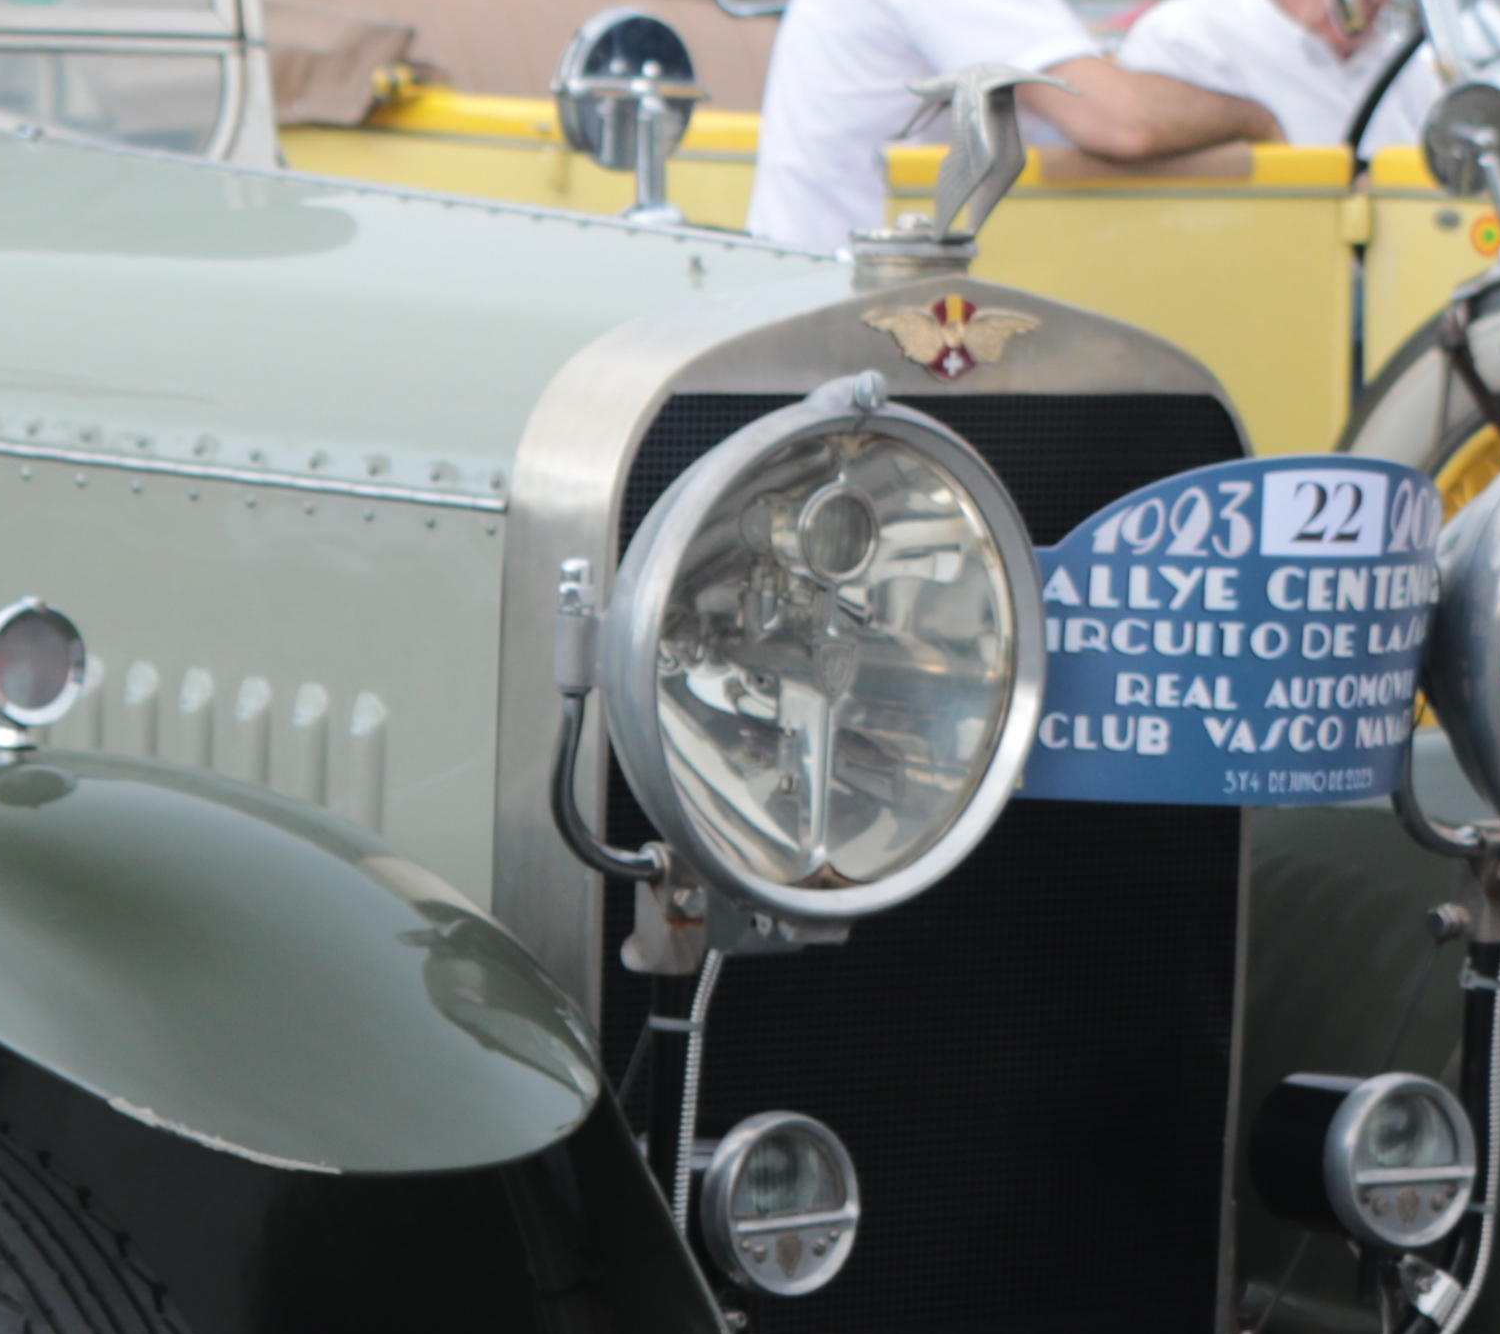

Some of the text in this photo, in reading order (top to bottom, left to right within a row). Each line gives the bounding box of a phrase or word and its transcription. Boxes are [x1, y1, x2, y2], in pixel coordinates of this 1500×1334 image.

[1092, 481, 1254, 559] 1923
[1290, 481, 1363, 543] 22
[1042, 565, 1238, 611] ALLYE
[1046, 617, 1290, 659] IRCUITO
[1301, 622, 1357, 660] DE
[1115, 672, 1238, 710] REAL
[1038, 712, 1170, 755] CLUB
[1203, 714, 1344, 753] VASCO
